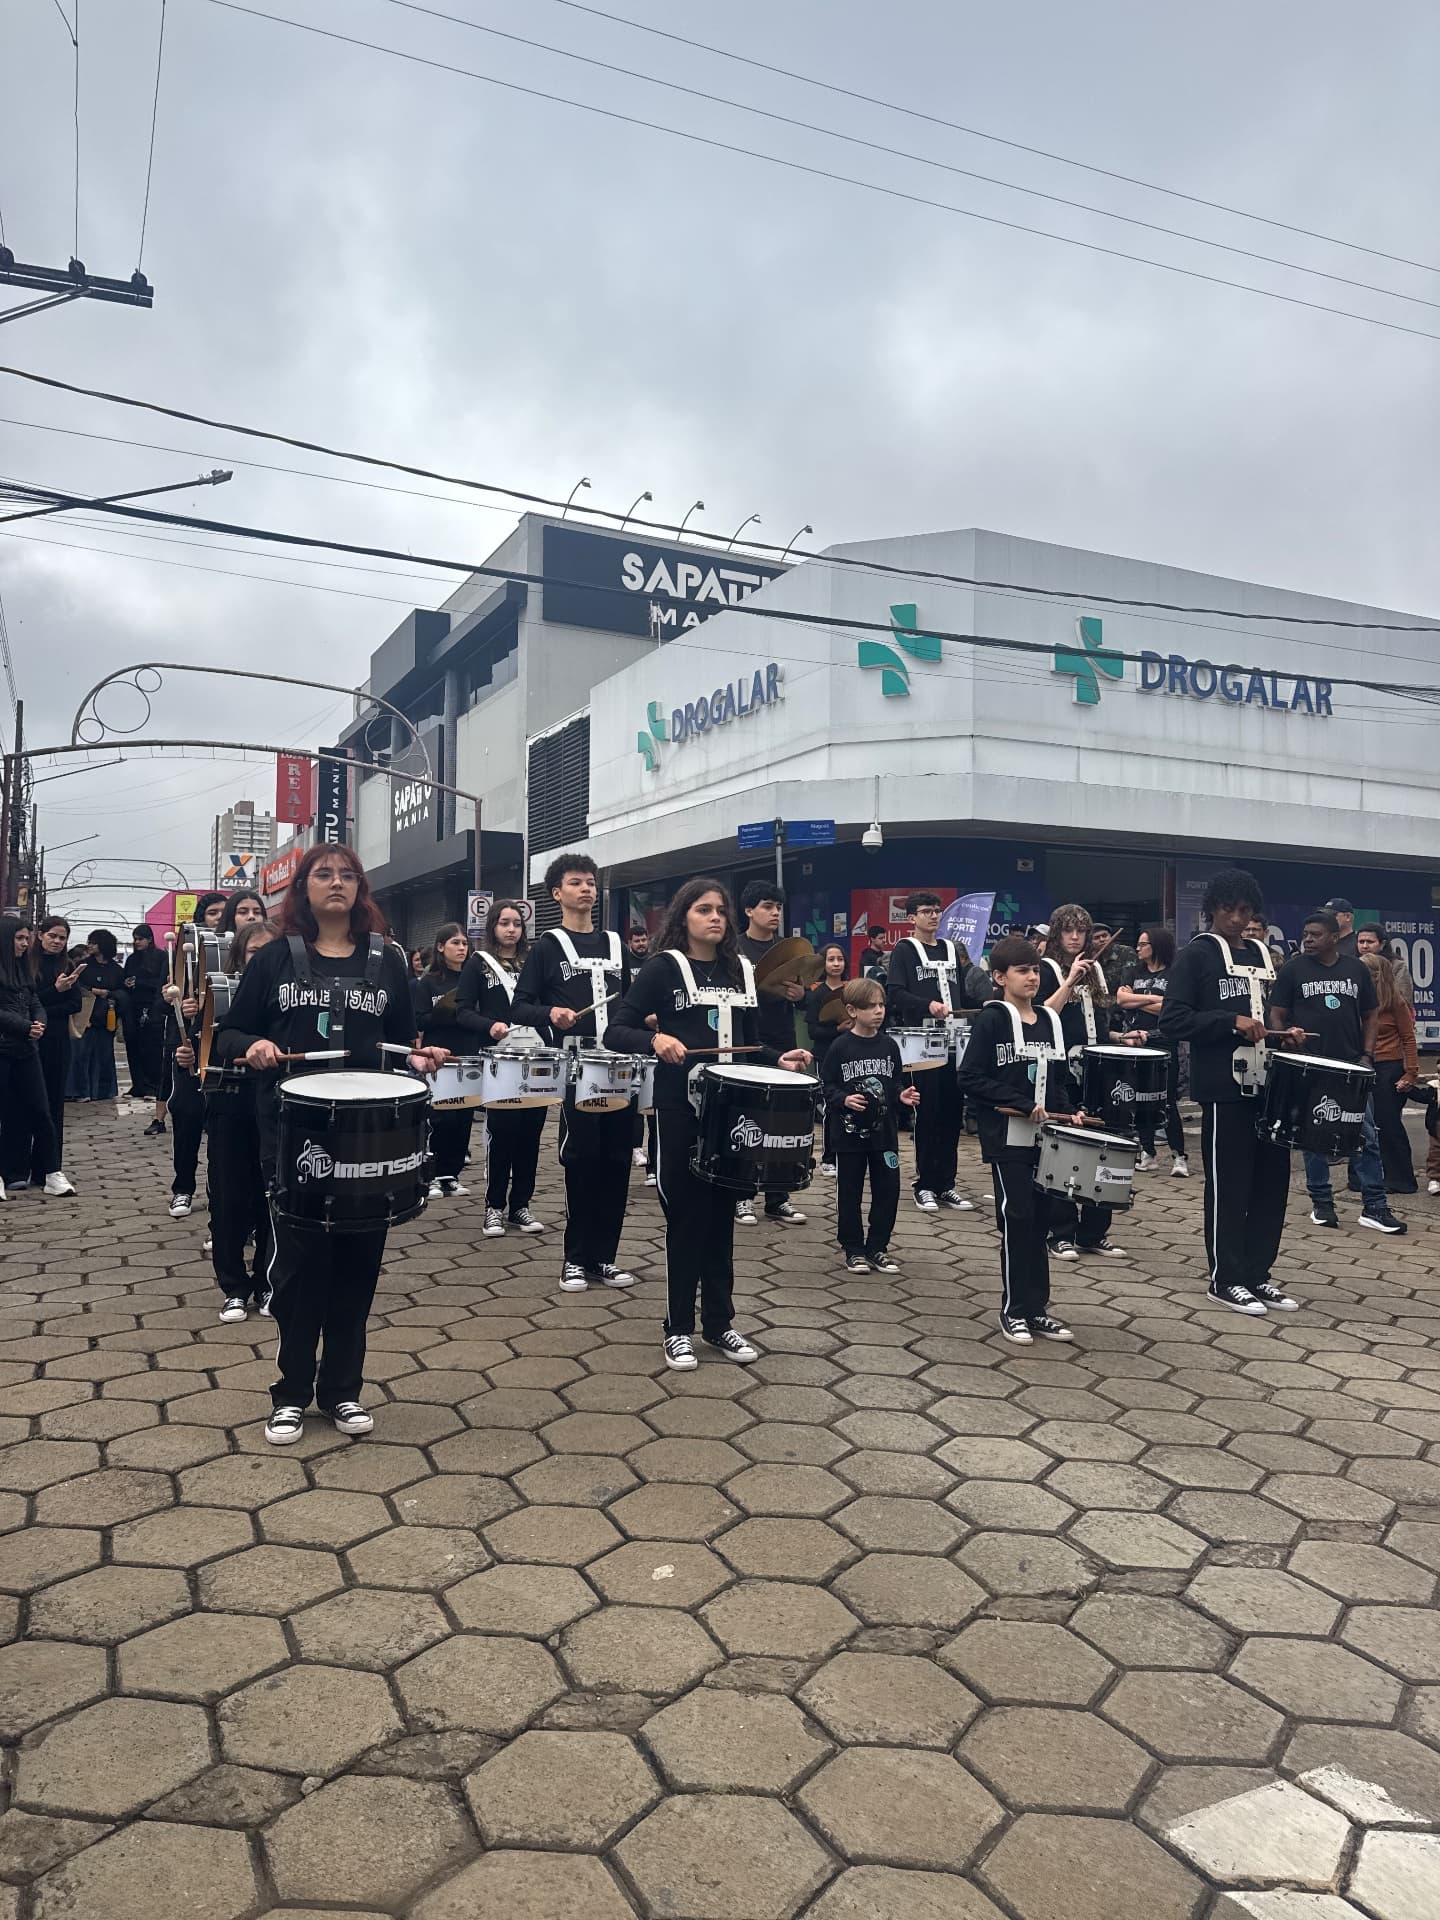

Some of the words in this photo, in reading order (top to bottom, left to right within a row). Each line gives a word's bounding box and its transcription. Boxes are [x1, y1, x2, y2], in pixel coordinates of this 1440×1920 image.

[1138, 650, 1332, 716] DROGALAR
[672, 662, 779, 742] DROGALAR
[288, 763, 301, 818] REAL
[396, 806, 429, 832] MANIA
[222, 879, 251, 887] CAIXA
[477, 901, 485, 914] E
[947, 922, 976, 932] FORTE
[1385, 921, 1416, 933] CHEQUE
[1418, 921, 1434, 934] PRÉ
[1414, 991, 1434, 1004] DIAS
